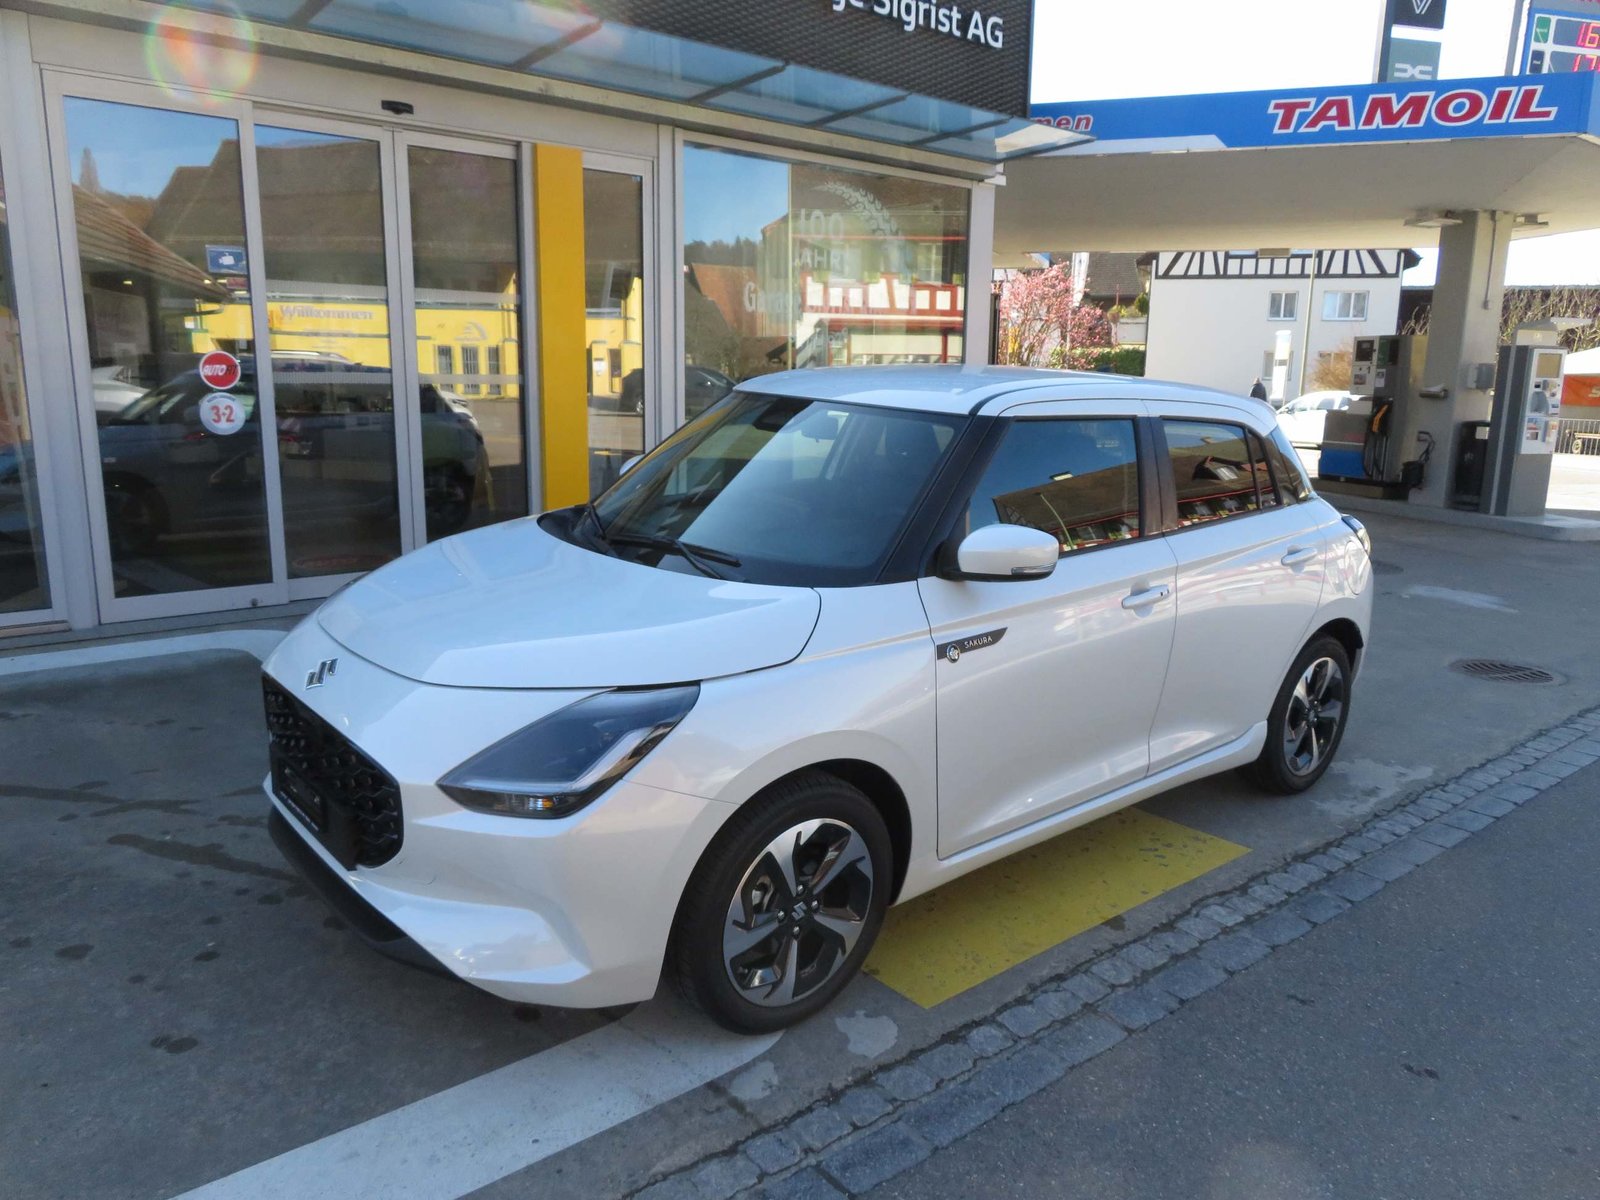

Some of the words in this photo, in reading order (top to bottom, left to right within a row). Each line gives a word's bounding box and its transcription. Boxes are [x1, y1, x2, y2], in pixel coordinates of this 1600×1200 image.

[967, 11, 1003, 49] AG
[1267, 85, 1558, 134] TAMOIL
[964, 635, 993, 649] SAKURA
